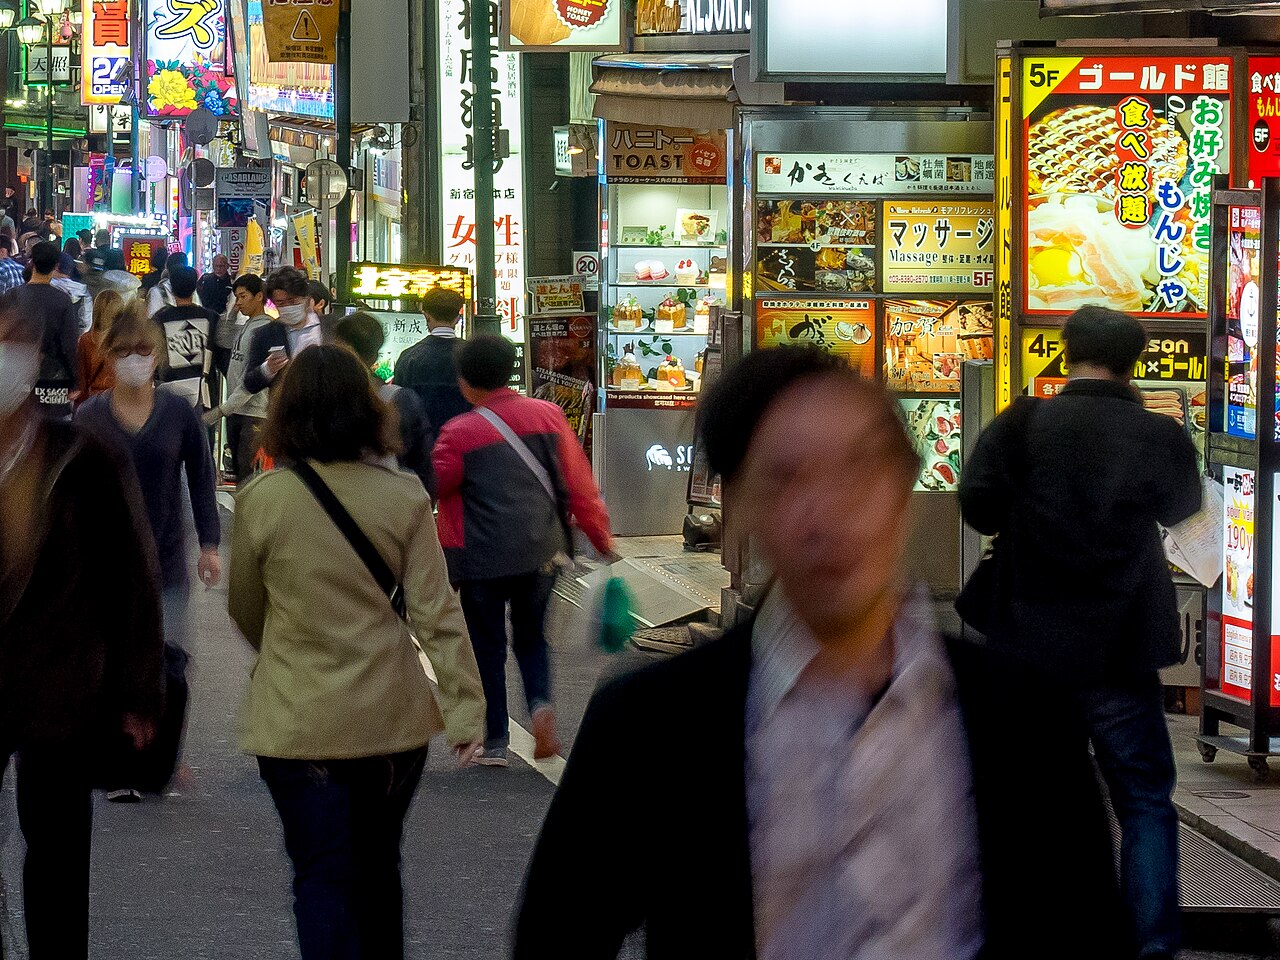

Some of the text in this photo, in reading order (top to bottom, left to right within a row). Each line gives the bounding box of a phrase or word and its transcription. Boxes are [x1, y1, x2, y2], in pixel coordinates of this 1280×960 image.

[566, 5, 593, 17] HONEY
[1028, 63, 1060, 88] 5F
[1078, 62, 1230, 91] ゴールド館
[611, 129, 694, 150] ハニトー
[1253, 127, 1270, 144] 5F
[612, 154, 684, 170] TOAST
[1118, 97, 1152, 224] 食べ放題
[1191, 96, 1221, 252] お好み焼き
[446, 214, 520, 248] 女性
[888, 218, 995, 251] マッサージ
[1154, 180, 1186, 309] もんじゃ
[579, 260, 596, 272] 20
[889, 249, 939, 266] Massage
[973, 271, 993, 287] 5F
[890, 316, 937, 339] 加賀
[1028, 333, 1058, 358] 4F
